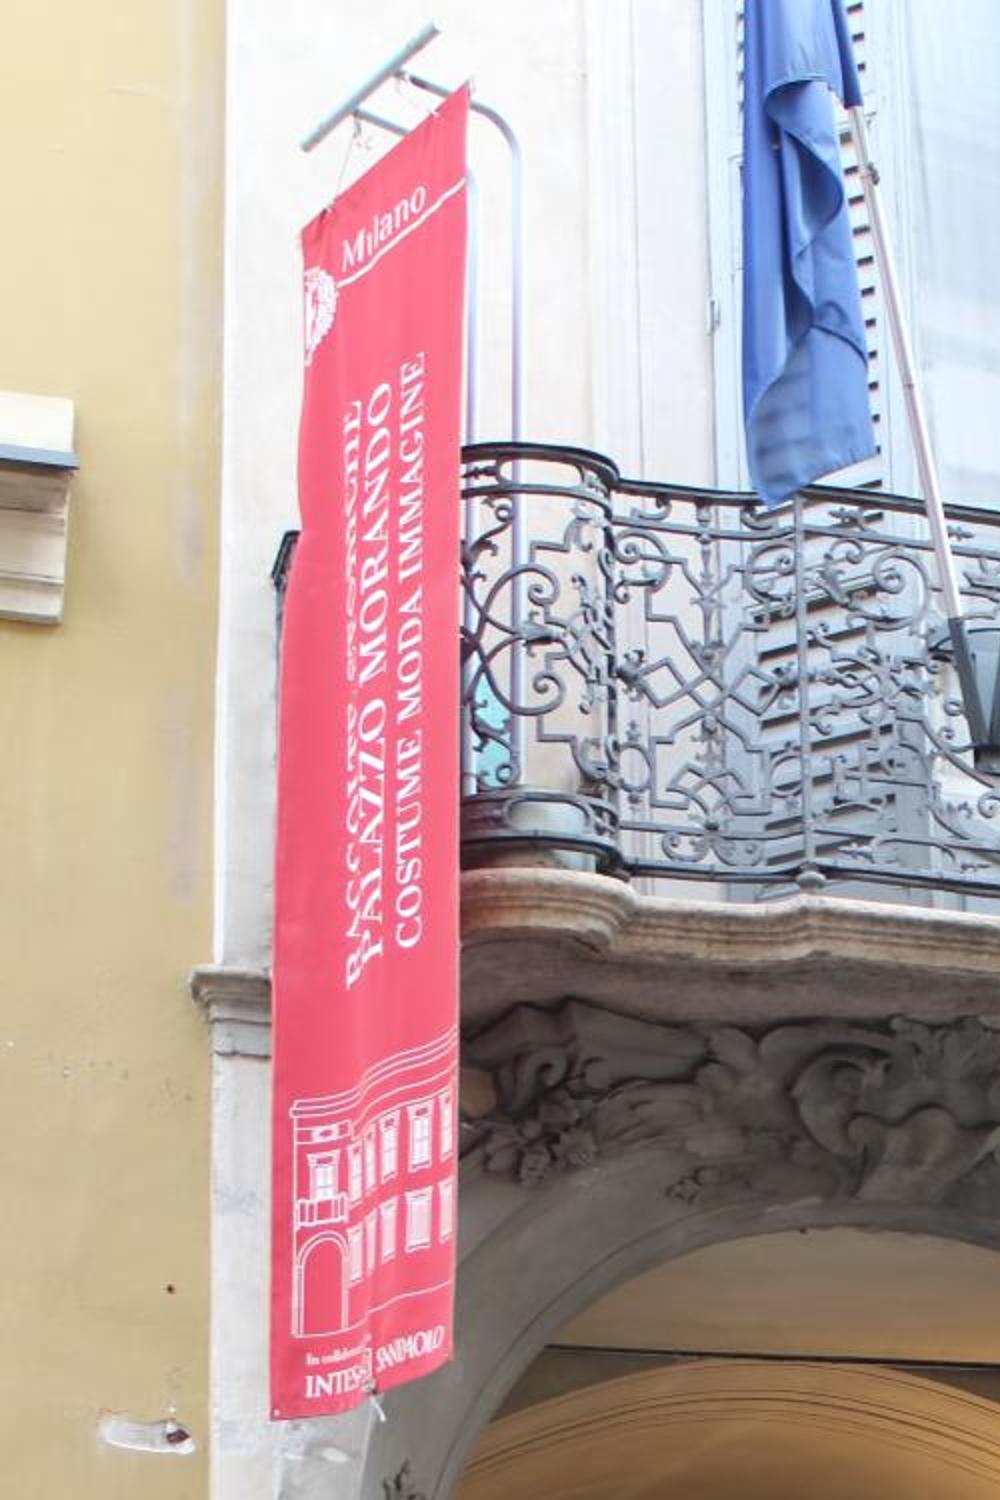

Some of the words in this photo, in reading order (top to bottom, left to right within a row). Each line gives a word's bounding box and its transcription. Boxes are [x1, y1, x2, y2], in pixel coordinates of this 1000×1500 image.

[341, 186, 426, 273] Milano
[358, 382, 392, 687] MORANDO
[398, 350, 425, 580] IMMAGINE
[396, 582, 423, 725] MODA
[357, 697, 387, 962] PALAZZO
[395, 727, 423, 948] COSTUME
